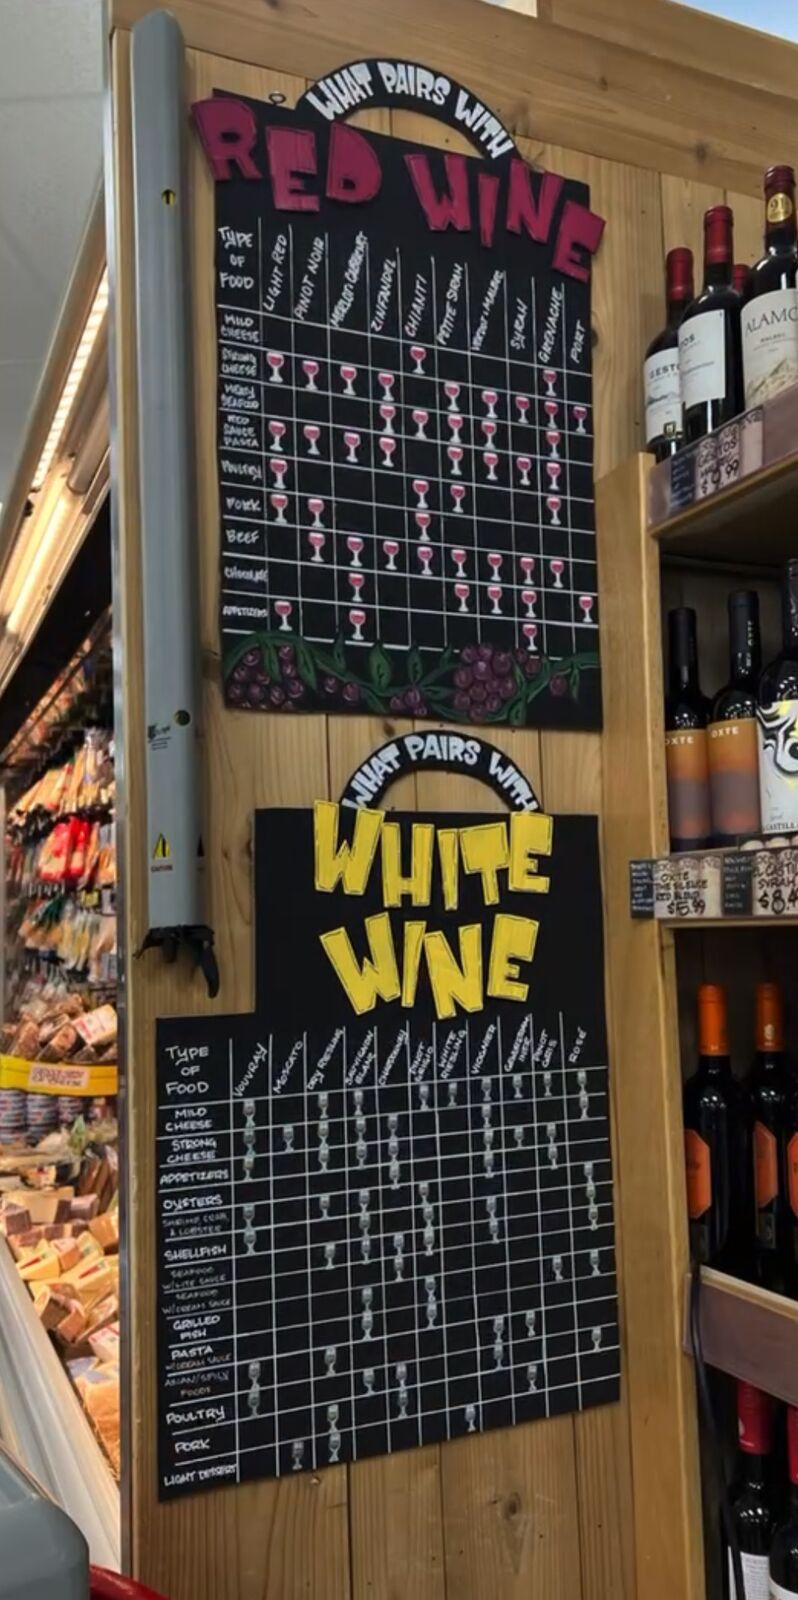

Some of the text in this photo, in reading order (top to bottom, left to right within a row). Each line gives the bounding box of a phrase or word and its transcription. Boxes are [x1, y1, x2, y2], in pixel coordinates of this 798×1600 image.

[305, 61, 514, 159] WHAT PAIRS WITH
[191, 97, 606, 282] RED WINE
[218, 226, 253, 249] TYPE
[229, 254, 245, 267] OF
[219, 272, 254, 290] FOOD
[263, 234, 287, 311] LIGHT RED
[294, 236, 324, 320] PINOT NOIR
[371, 258, 396, 332] ZINFANDEL
[404, 273, 428, 338] CHIANTI
[224, 314, 254, 327] MILD
[220, 325, 260, 343] CHEESE
[570, 319, 586, 363] PORT
[221, 459, 262, 480] POULTRY
[226, 497, 261, 512] PORK
[225, 529, 260, 544] BEEF
[712, 726, 739, 738] OXTE
[342, 735, 538, 812] WHAT PAIRS WITH
[314, 800, 553, 911] WHITE
[319, 912, 540, 1020] WINE
[164, 1045, 209, 1067] TYPE
[438, 1030, 456, 1068] WHITE
[471, 1023, 496, 1075] VIOGNIER
[180, 1065, 200, 1077] OF
[232, 1042, 268, 1098] VOUVRAY
[272, 1040, 303, 1094] MOSCATO
[165, 1081, 209, 1095] FOOD
[306, 1072, 325, 1090] DRY
[175, 1107, 207, 1119] MILD
[165, 1119, 212, 1132] CHEESE
[171, 1137, 217, 1151] STRONG
[167, 1151, 217, 1164] CHEESE
[160, 1168, 229, 1186] APPETIZERS
[162, 1194, 223, 1212] OYSTERS
[164, 1244, 227, 1261] SHELLFISH
[172, 1314, 221, 1331] GRILLED
[180, 1327, 207, 1340] FISH
[171, 1345, 214, 1360] PASTA
[166, 1405, 226, 1425] POULTRY
[174, 1438, 211, 1454] PORK
[164, 1468, 197, 1487] LIGHT
